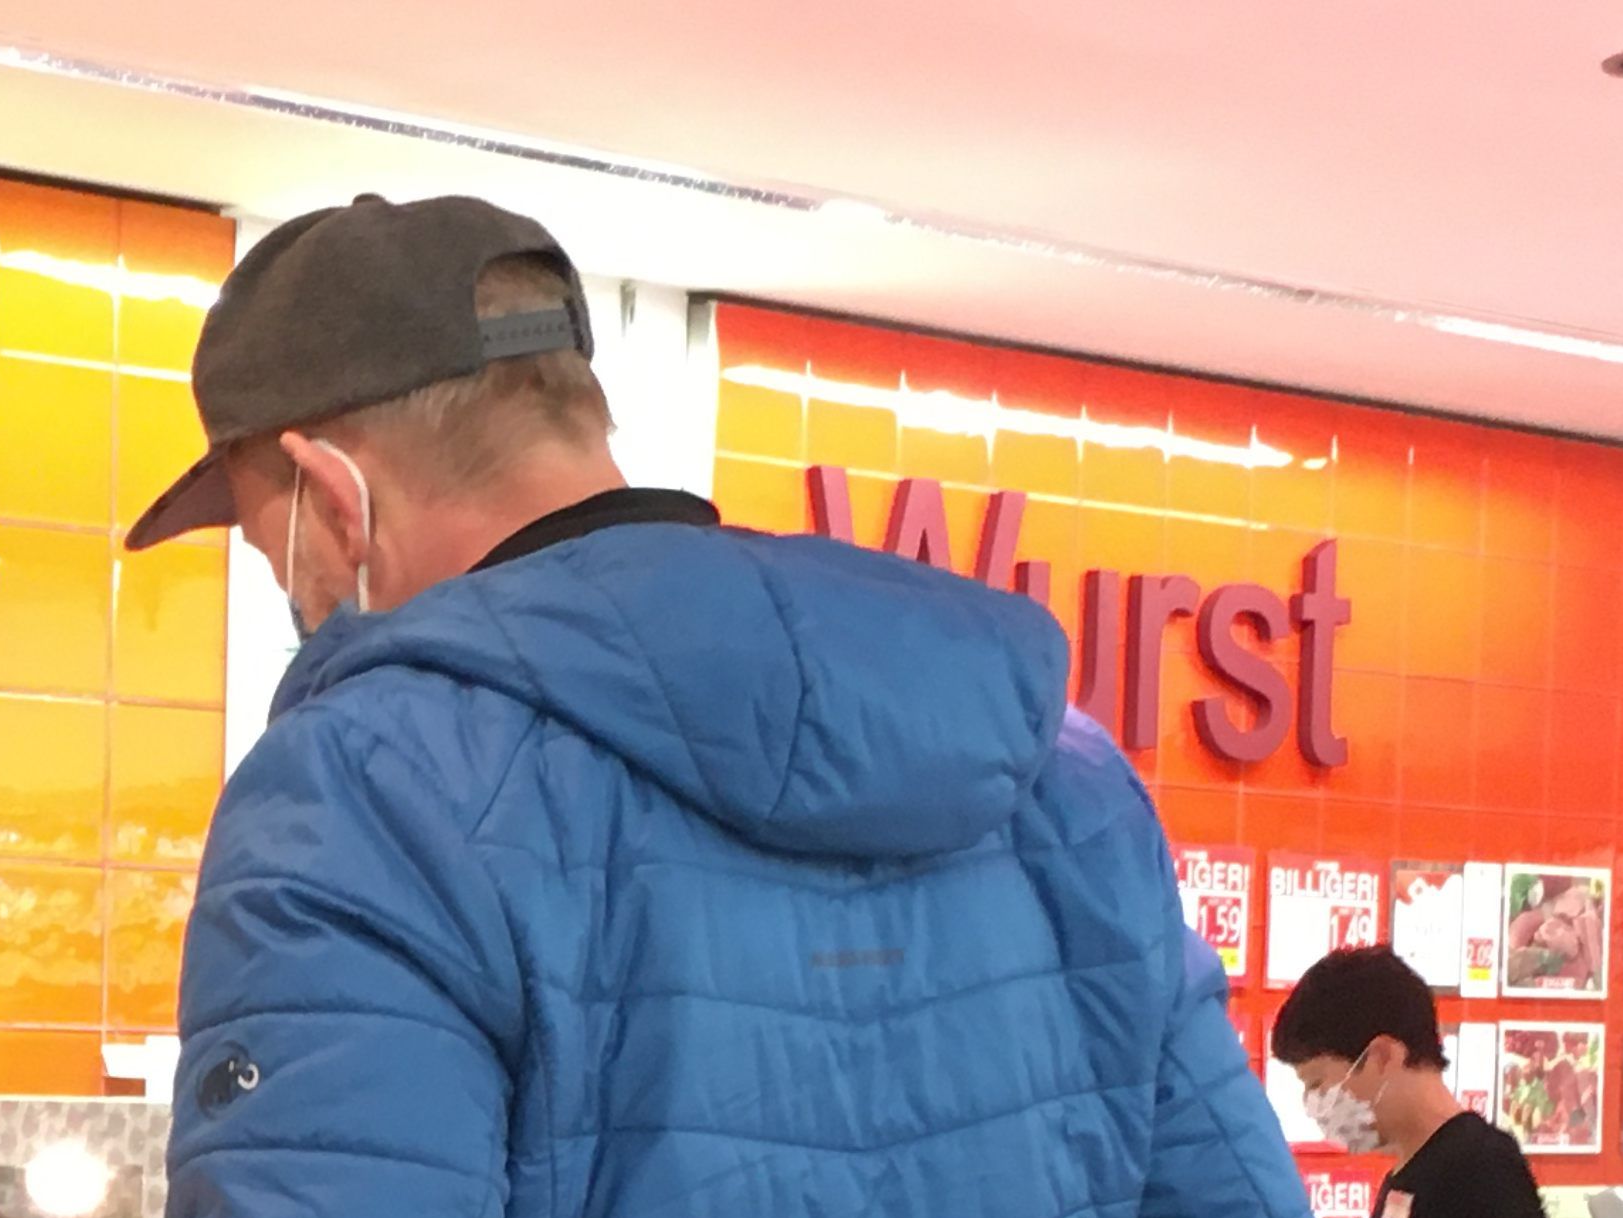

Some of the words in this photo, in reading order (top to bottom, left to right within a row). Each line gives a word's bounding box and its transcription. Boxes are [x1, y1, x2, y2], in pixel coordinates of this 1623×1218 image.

[1270, 866, 1379, 902] BILLIGER!
[1200, 904, 1242, 944] 1.59
[1311, 1183, 1370, 1210] IGER!
